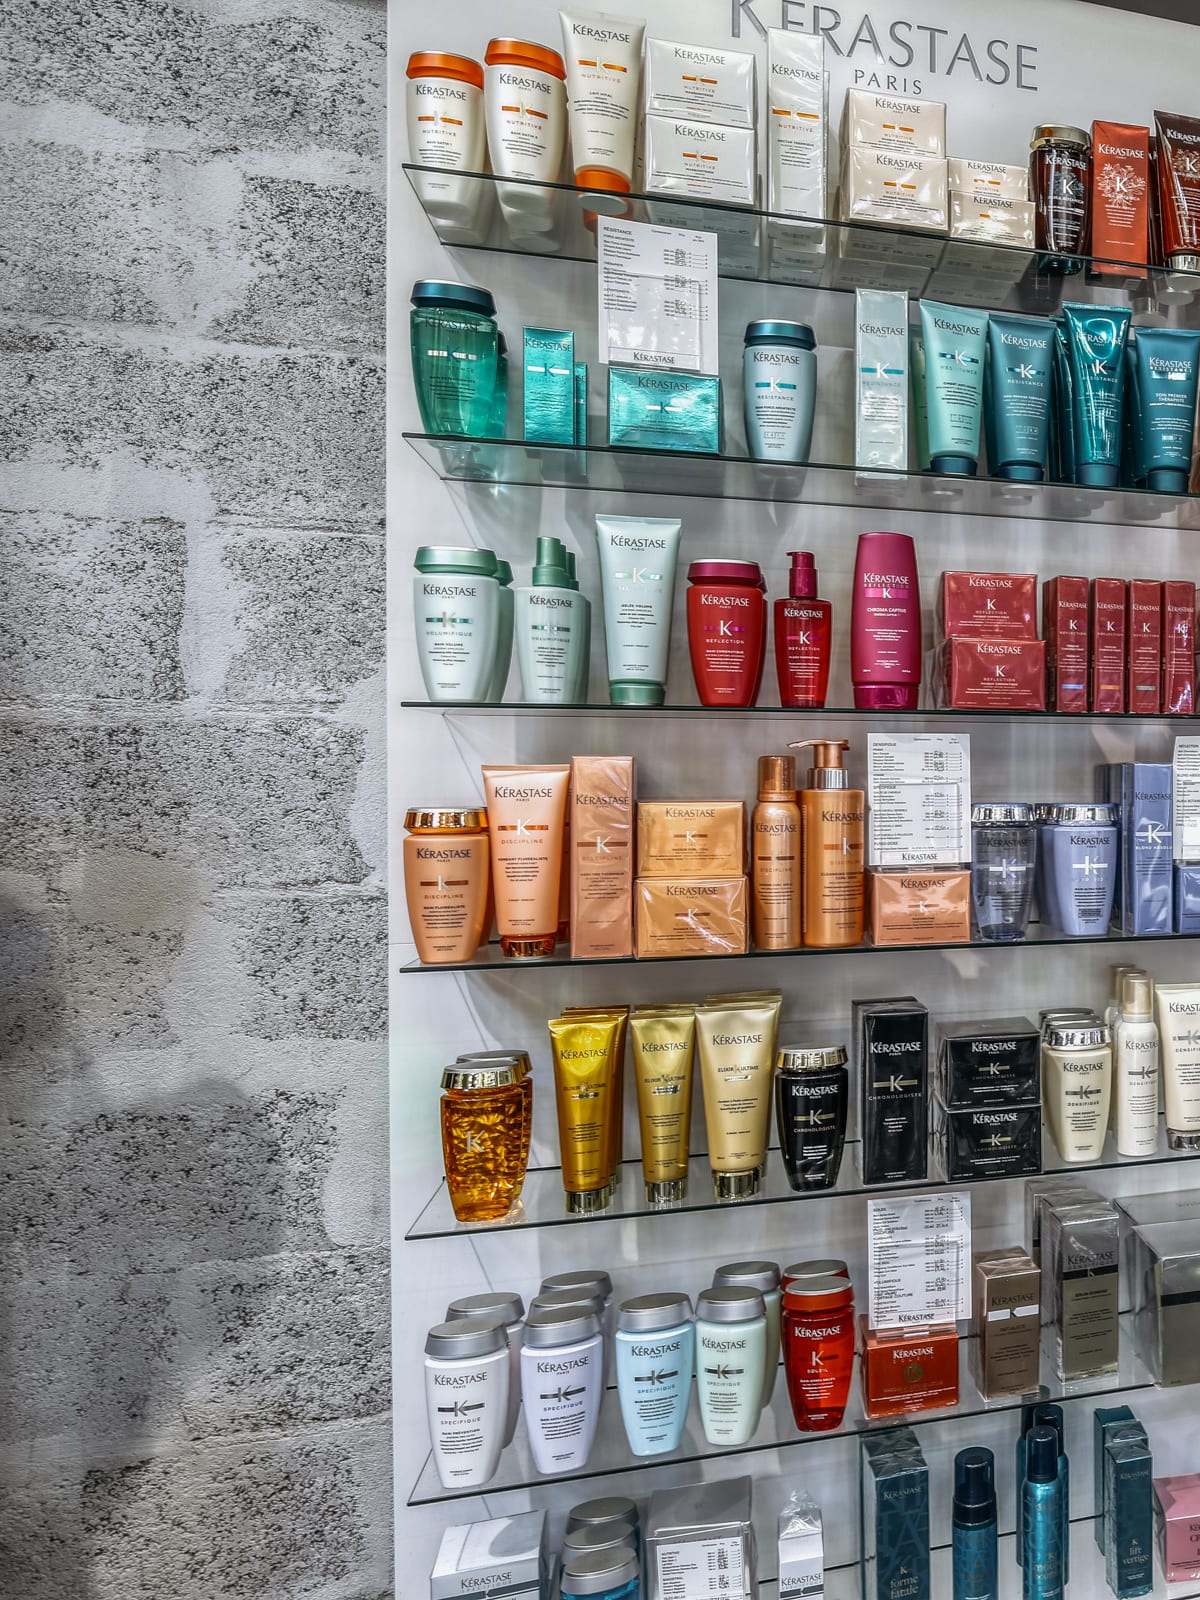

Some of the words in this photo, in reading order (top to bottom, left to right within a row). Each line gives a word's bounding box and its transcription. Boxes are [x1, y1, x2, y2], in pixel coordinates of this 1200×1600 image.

[572, 24, 631, 43] KÉRASTASE
[771, 63, 820, 81] KÉRASTASE
[499, 73, 552, 94] KÉRASTASE
[855, 69, 922, 95] PARIS
[416, 84, 467, 101] KÉRASTASE
[875, 97, 921, 114] KÉRASTASE
[674, 124, 726, 142] KÉRASTASE
[1098, 143, 1145, 159] KÉRASTASE
[1045, 155, 1087, 171] KÉRASTASE
[859, 323, 905, 336] KÉRASTASE
[933, 317, 980, 336] KÉRASTASE
[1000, 333, 1047, 349] KÉRASTASE
[633, 351, 675, 364] KÉRASTASE
[753, 351, 800, 365] KÉRASTASE
[1149, 357, 1192, 369] KÉRASTASE
[610, 535, 667, 549] KÉRASTASE
[863, 572, 909, 585] KÉRASTASE
[968, 577, 1013, 589] KÉRASTASE
[423, 583, 477, 597] KÉRASTASE
[529, 595, 574, 608] KÉRASTASE
[700, 593, 750, 608] KÉRASTASE
[783, 607, 823, 619] KÉRASTASE
[719, 620, 733, 636] K
[1069, 619, 1078, 630] K
[799, 631, 810, 644] K
[977, 643, 1022, 655] KÉRASTASE
[995, 665, 1006, 677] K
[494, 786, 553, 798] KÉRASTASE
[1135, 791, 1173, 801] KÉRASTASE
[576, 794, 629, 806] KÉRASTASE
[664, 807, 716, 819] KÉRASTASE
[1070, 835, 1111, 846] KÉRASTASE
[416, 847, 472, 859] KÉRASTASE
[901, 852, 937, 861] KÉRASTASE
[900, 878, 947, 889] KÉRASTASE
[666, 885, 719, 897] KÉRASTASE
[712, 1034, 763, 1046] KÉRASTASE
[560, 1047, 608, 1059] KÉRASTASE
[641, 1041, 689, 1053] KÉRASTASE
[869, 1041, 921, 1054] KÉRASTASE
[971, 1041, 1017, 1053] KÉRASTASE
[990, 1062, 1000, 1075] K
[1063, 1061, 1105, 1074] KÉRASTASE
[890, 1074, 904, 1092] K
[791, 1084, 839, 1097] KÉRASTASE
[809, 1109, 822, 1126] K
[973, 1112, 1018, 1125] KÉRASTASE
[466, 1129, 485, 1153] K
[991, 1133, 1001, 1146] K
[1067, 1250, 1114, 1265] KÉRASTASE
[794, 1325, 841, 1337] KÉRASTASE
[631, 1341, 681, 1357] KÉRASTASE
[702, 1337, 747, 1350] KÉRASTASE
[893, 1346, 934, 1359] KÉRASTASE
[537, 1356, 590, 1374] KÉRASTASE
[434, 1371, 488, 1386] KÉRASTASE
[543, 1400, 584, 1412] SPECIFIQUE
[440, 1416, 481, 1425] SPECIFIQUE
[1122, 1552, 1150, 1565] vertige
[460, 1571, 513, 1590] KÉRASTASE
[781, 1573, 823, 1587] KÉRASTASE
[890, 1575, 919, 1590] forme
